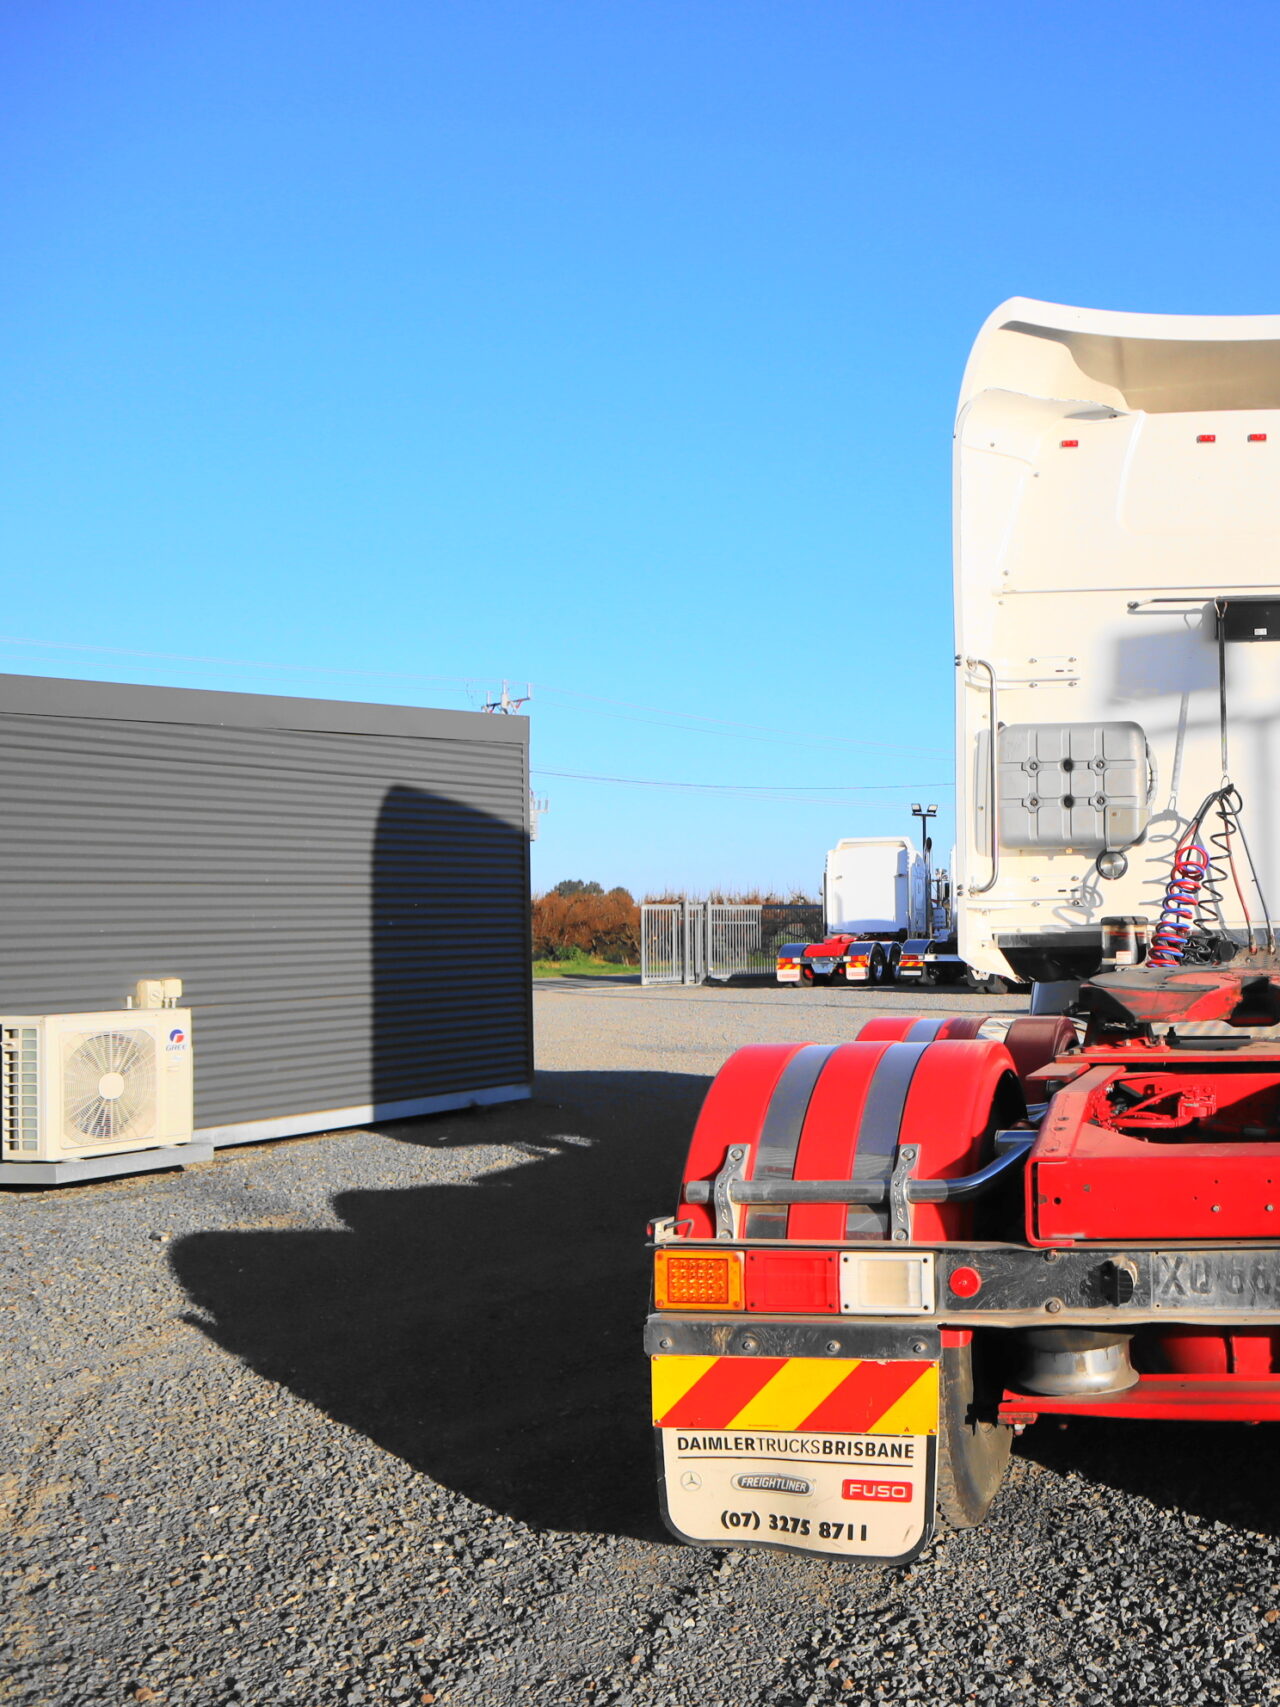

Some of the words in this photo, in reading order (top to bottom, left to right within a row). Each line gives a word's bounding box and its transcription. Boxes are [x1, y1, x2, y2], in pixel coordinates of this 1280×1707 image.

[741, 1476, 807, 1492] FREIGHTLINER
[849, 1483, 907, 1498] FUSO
[721, 1510, 760, 1530] (07)
[769, 1514, 810, 1535] 3275
[819, 1521, 867, 1541] 8711
